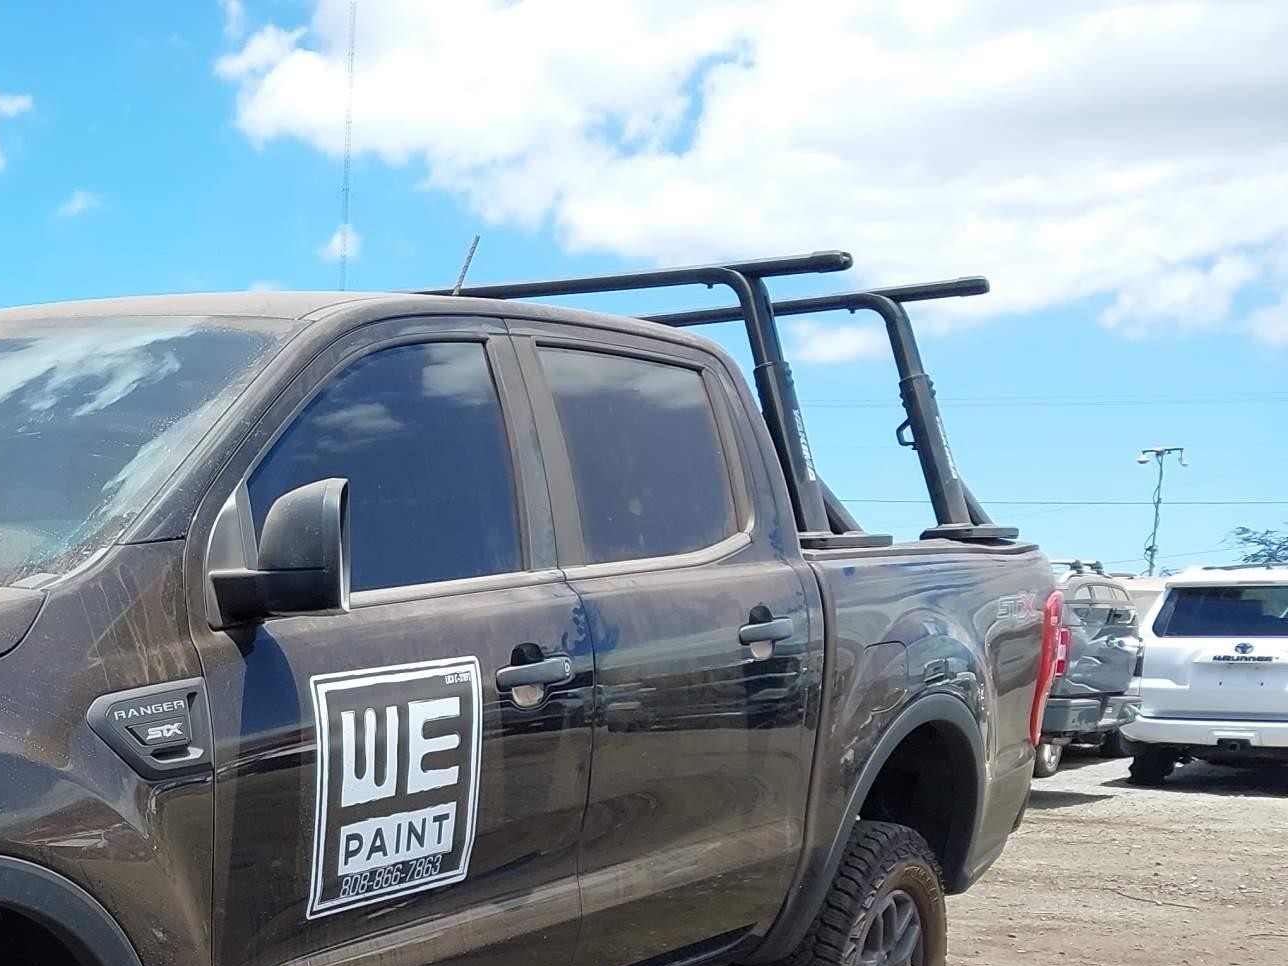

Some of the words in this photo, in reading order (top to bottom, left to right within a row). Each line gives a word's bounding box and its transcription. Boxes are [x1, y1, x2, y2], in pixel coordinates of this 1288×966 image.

[113, 700, 185, 720] RANGER
[146, 722, 183, 740] STX
[341, 696, 461, 807] WE
[343, 813, 450, 867] PAINT
[340, 854, 442, 897] 808-866-7863
